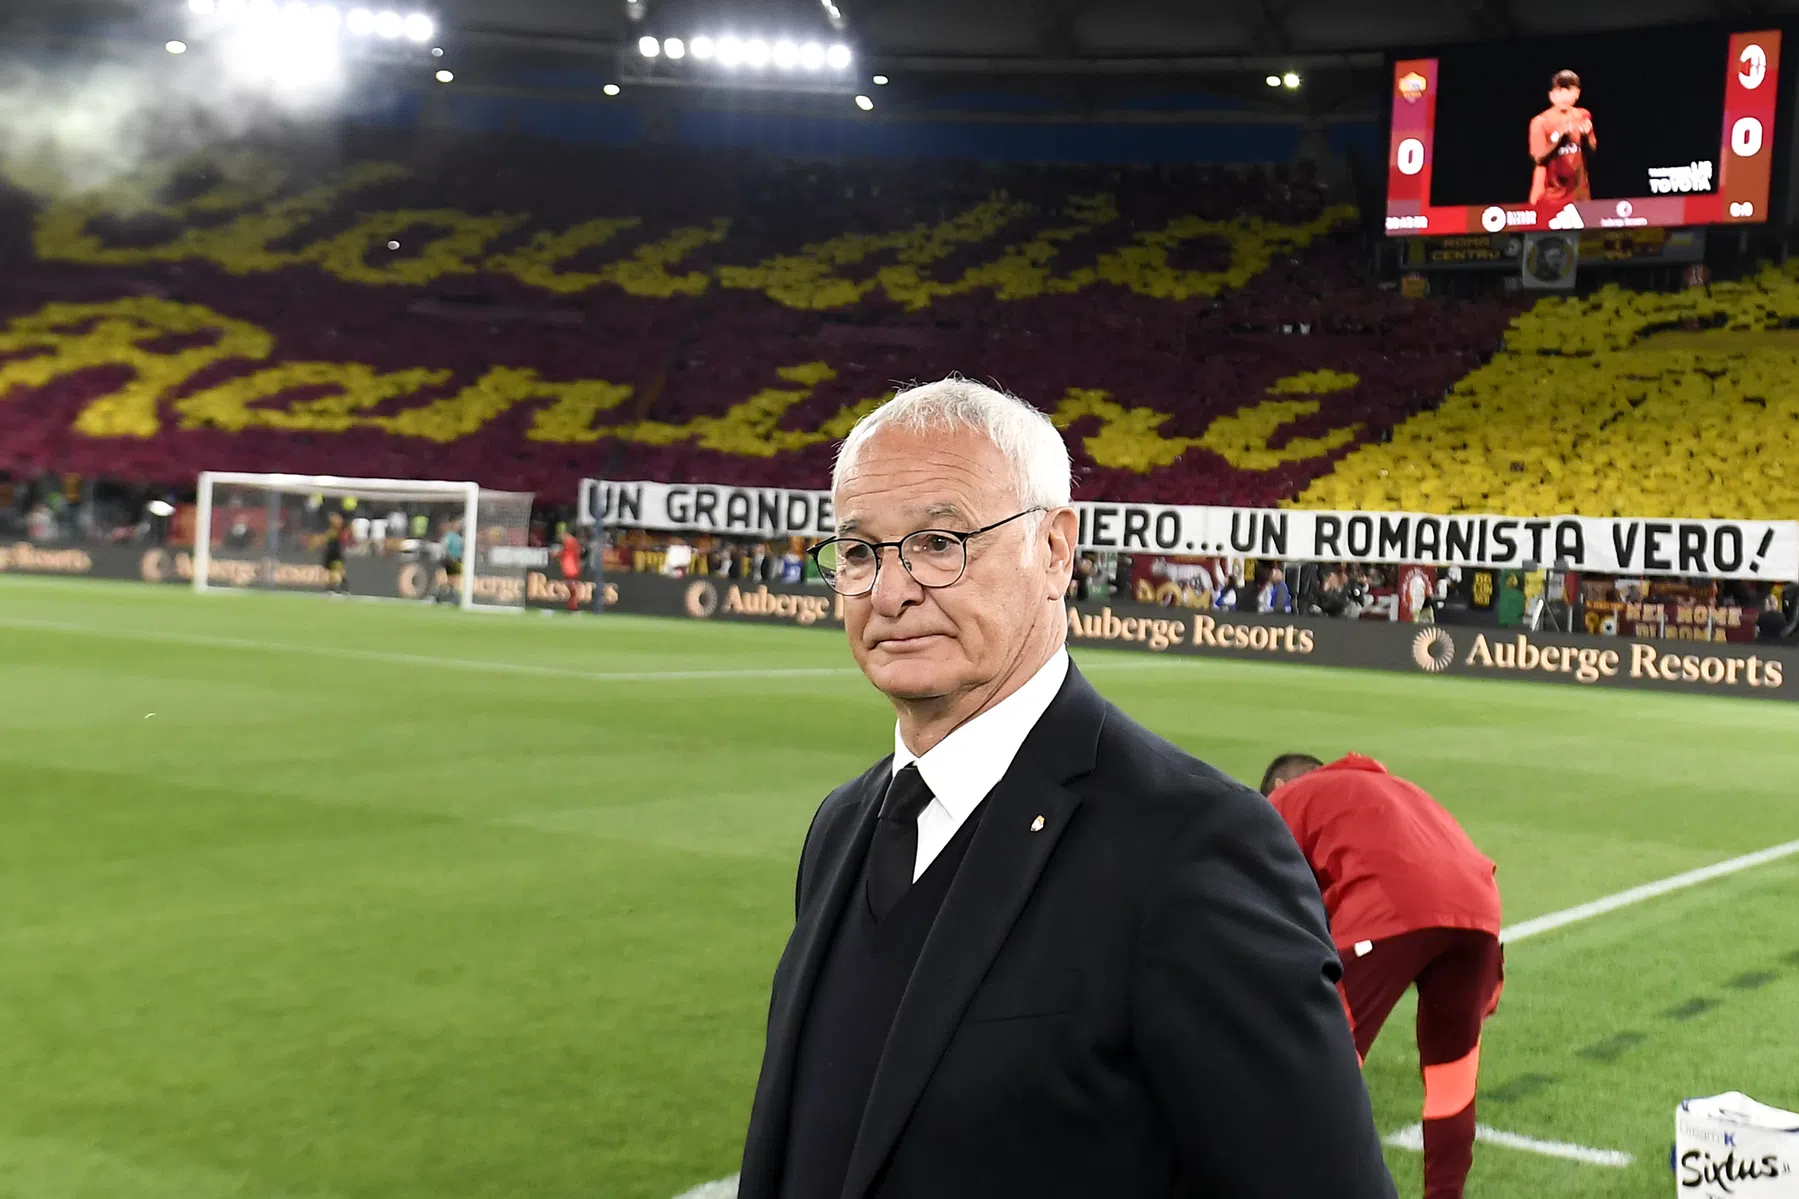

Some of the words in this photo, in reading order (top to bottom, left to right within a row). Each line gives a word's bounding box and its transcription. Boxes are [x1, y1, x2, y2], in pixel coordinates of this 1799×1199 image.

[1397, 138, 1424, 175] 0
[1731, 117, 1762, 157] 0
[588, 483, 642, 521] UN
[666, 490, 836, 532] GRANDE
[1314, 514, 1586, 565] ROMANISTA
[1612, 521, 1775, 573] VERO!
[721, 584, 830, 624] Auberge
[1068, 605, 1186, 651] Auberge
[1192, 615, 1315, 653] Resorts
[1465, 632, 1620, 684] Auberge
[1629, 643, 1784, 689] Resorts
